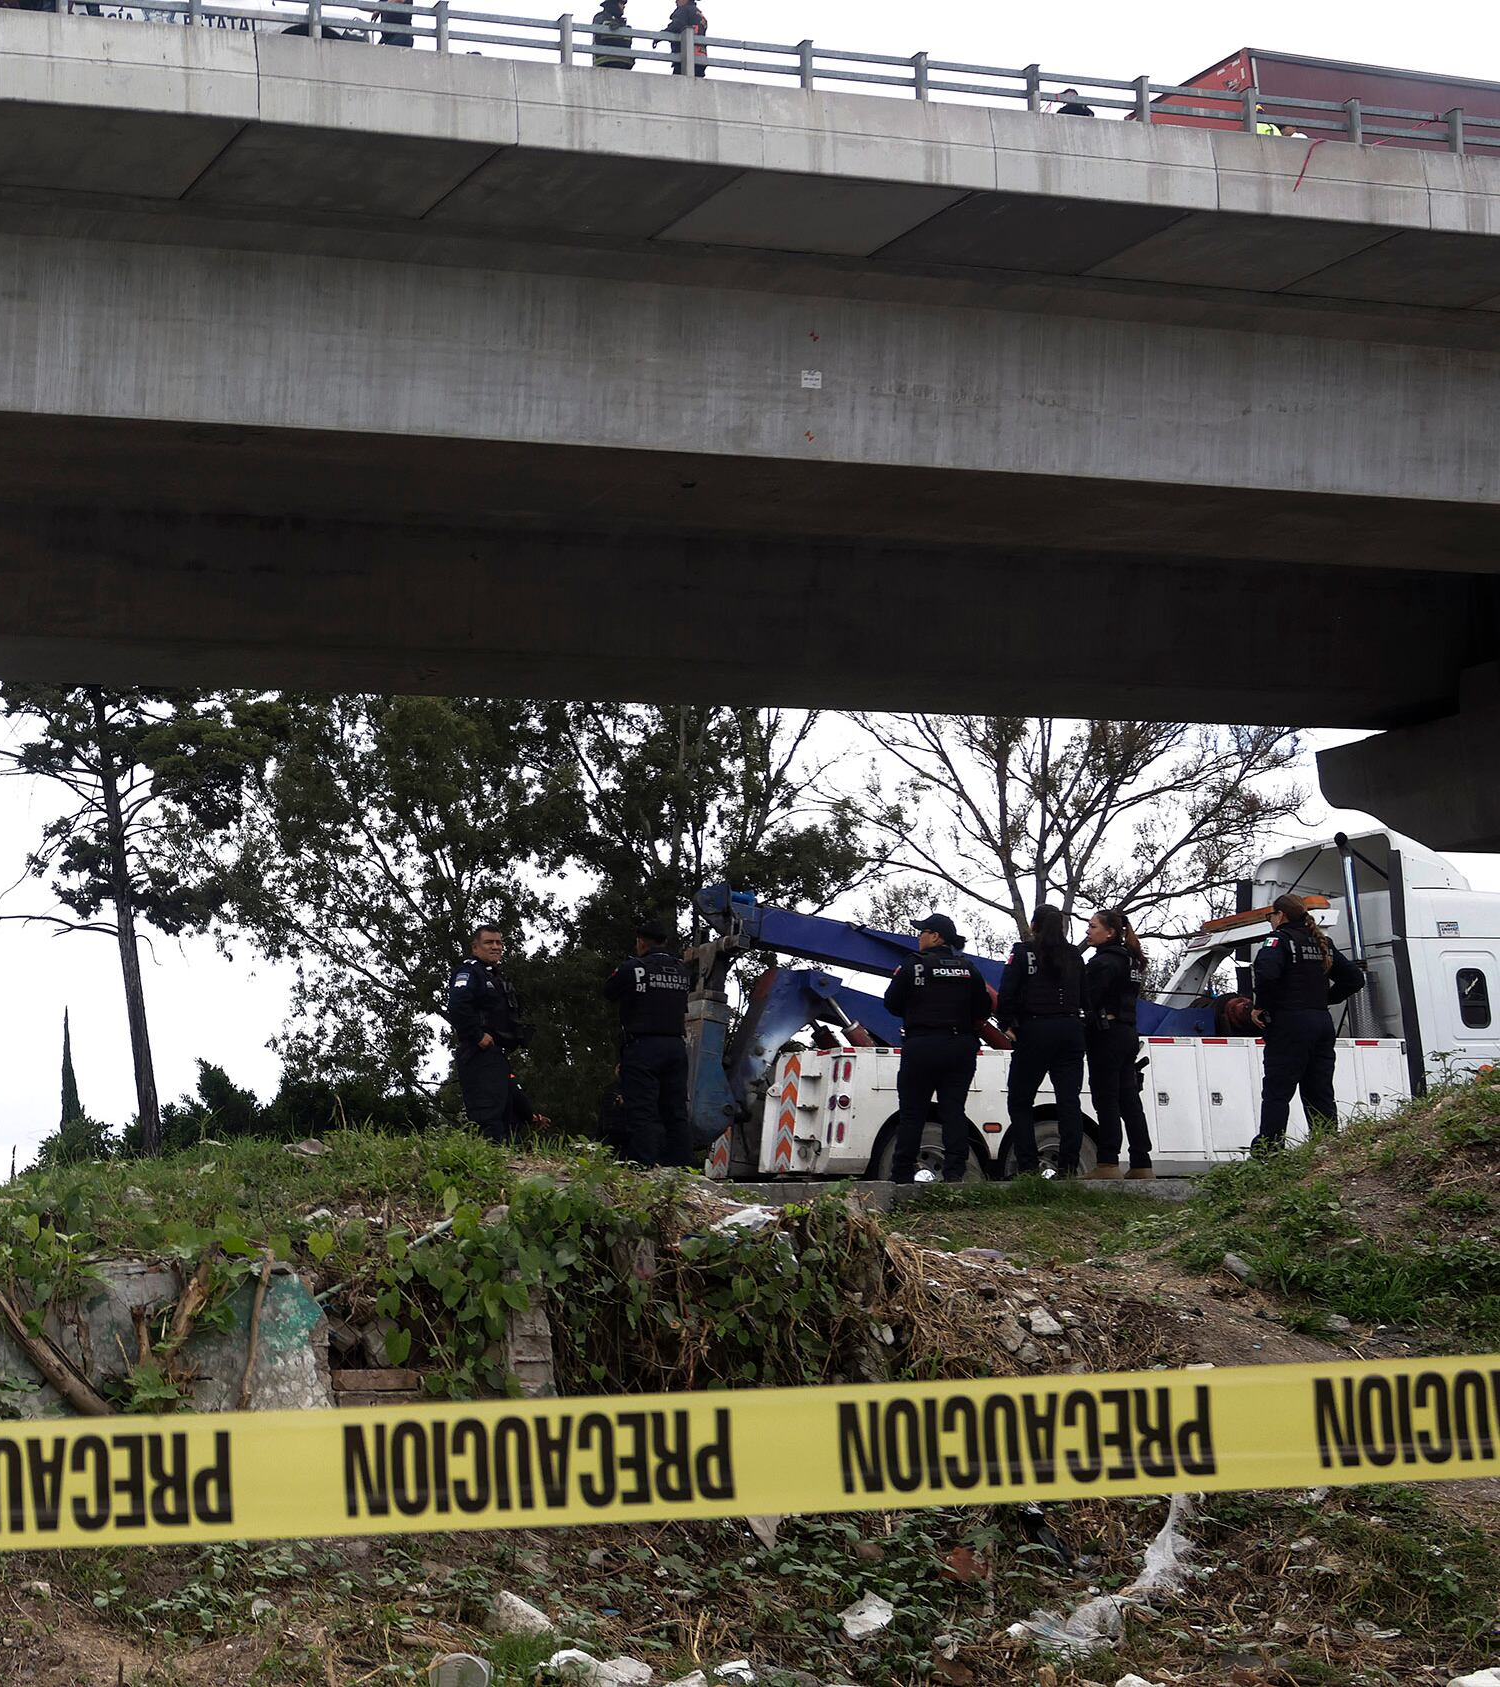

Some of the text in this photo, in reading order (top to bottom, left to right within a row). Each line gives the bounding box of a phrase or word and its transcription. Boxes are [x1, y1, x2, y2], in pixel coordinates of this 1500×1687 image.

[634, 966, 646, 982] P
[913, 963, 925, 976] P
[932, 968, 971, 977] POLICIA
[839, 1385, 1217, 1494] PRECAUCION
[1314, 1369, 1500, 1469] UCION
[343, 1408, 736, 1518] PRECAUCION
